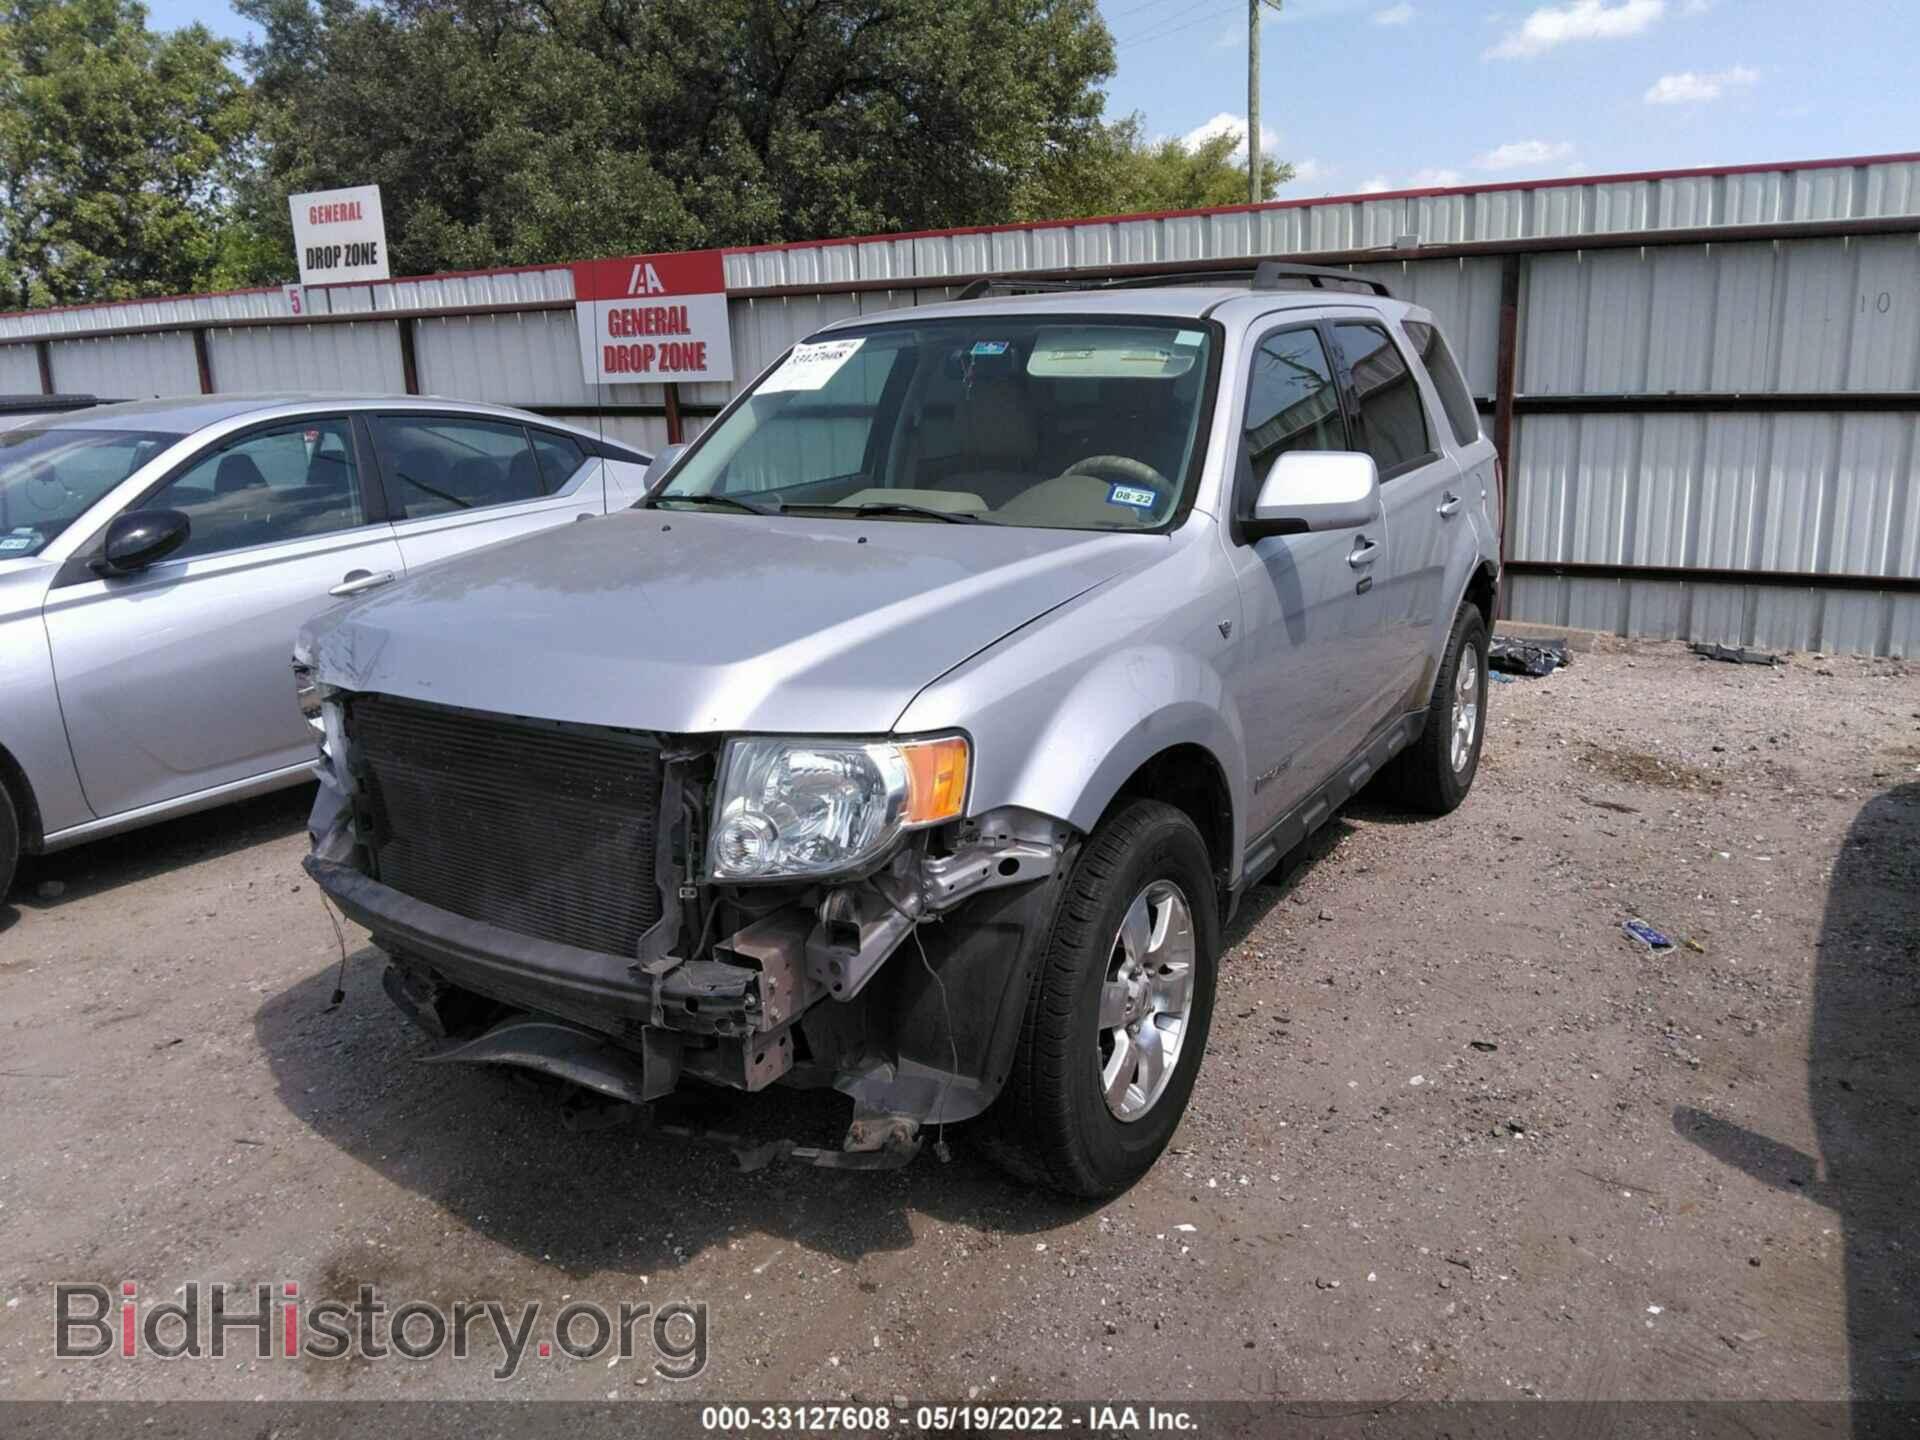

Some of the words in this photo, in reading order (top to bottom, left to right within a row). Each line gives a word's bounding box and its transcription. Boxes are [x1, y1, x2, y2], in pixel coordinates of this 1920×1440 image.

[309, 202, 362, 225] GENERAL
[306, 246, 341, 270] DROP
[344, 242, 377, 267] ZONE
[289, 289, 301, 314] 5
[608, 305, 691, 338] GENERAL
[604, 344, 656, 373] DROP
[658, 342, 707, 372] ZONE
